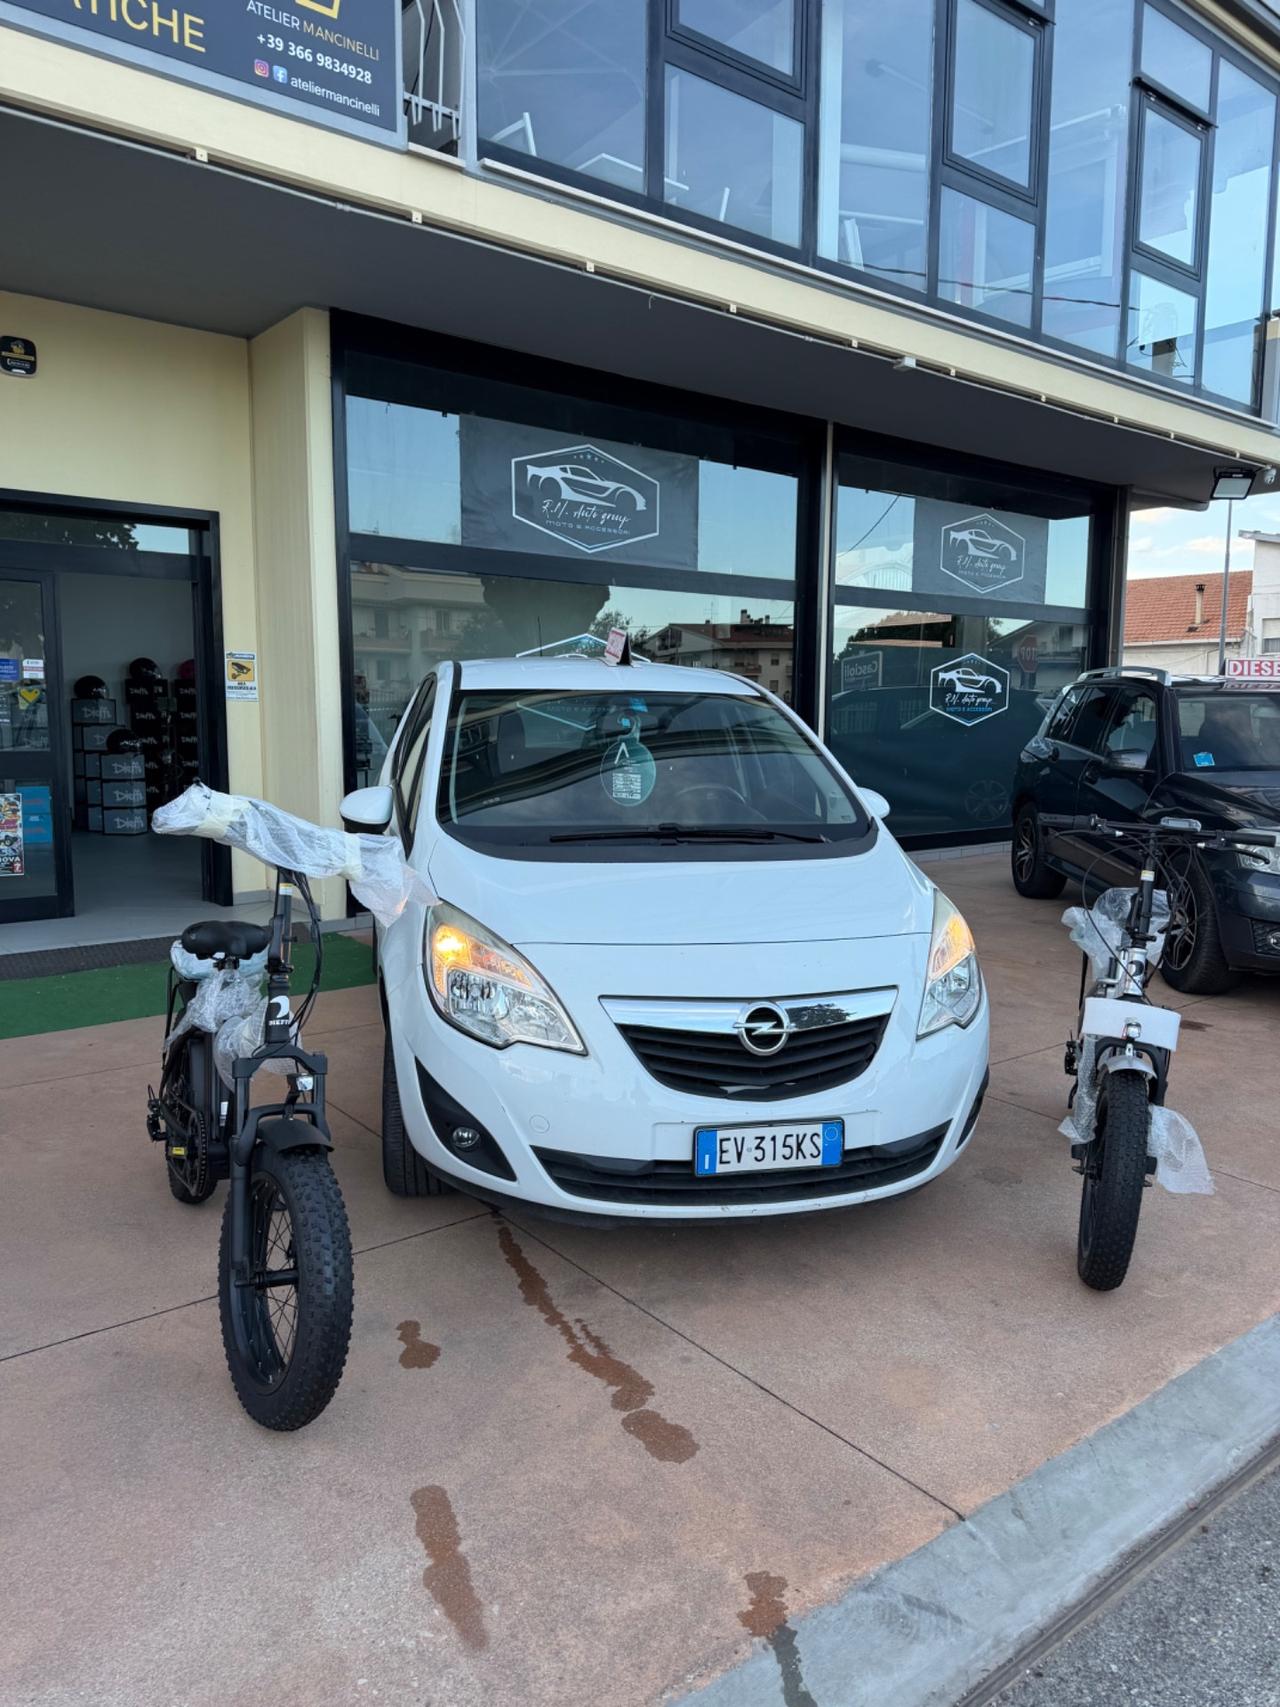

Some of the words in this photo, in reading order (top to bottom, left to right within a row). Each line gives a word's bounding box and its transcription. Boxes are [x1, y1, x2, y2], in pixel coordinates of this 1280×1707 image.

[72, 0, 206, 53] ICHE
[247, 0, 300, 30] ATELIER
[303, 21, 380, 61] MANCINELLI
[257, 34, 284, 51] +39
[288, 42, 313, 62] 366
[316, 53, 372, 84] 9834928
[290, 76, 380, 116] ateliermancinelli
[719, 1136, 745, 1165] EV
[754, 1132, 821, 1163] 315KS
